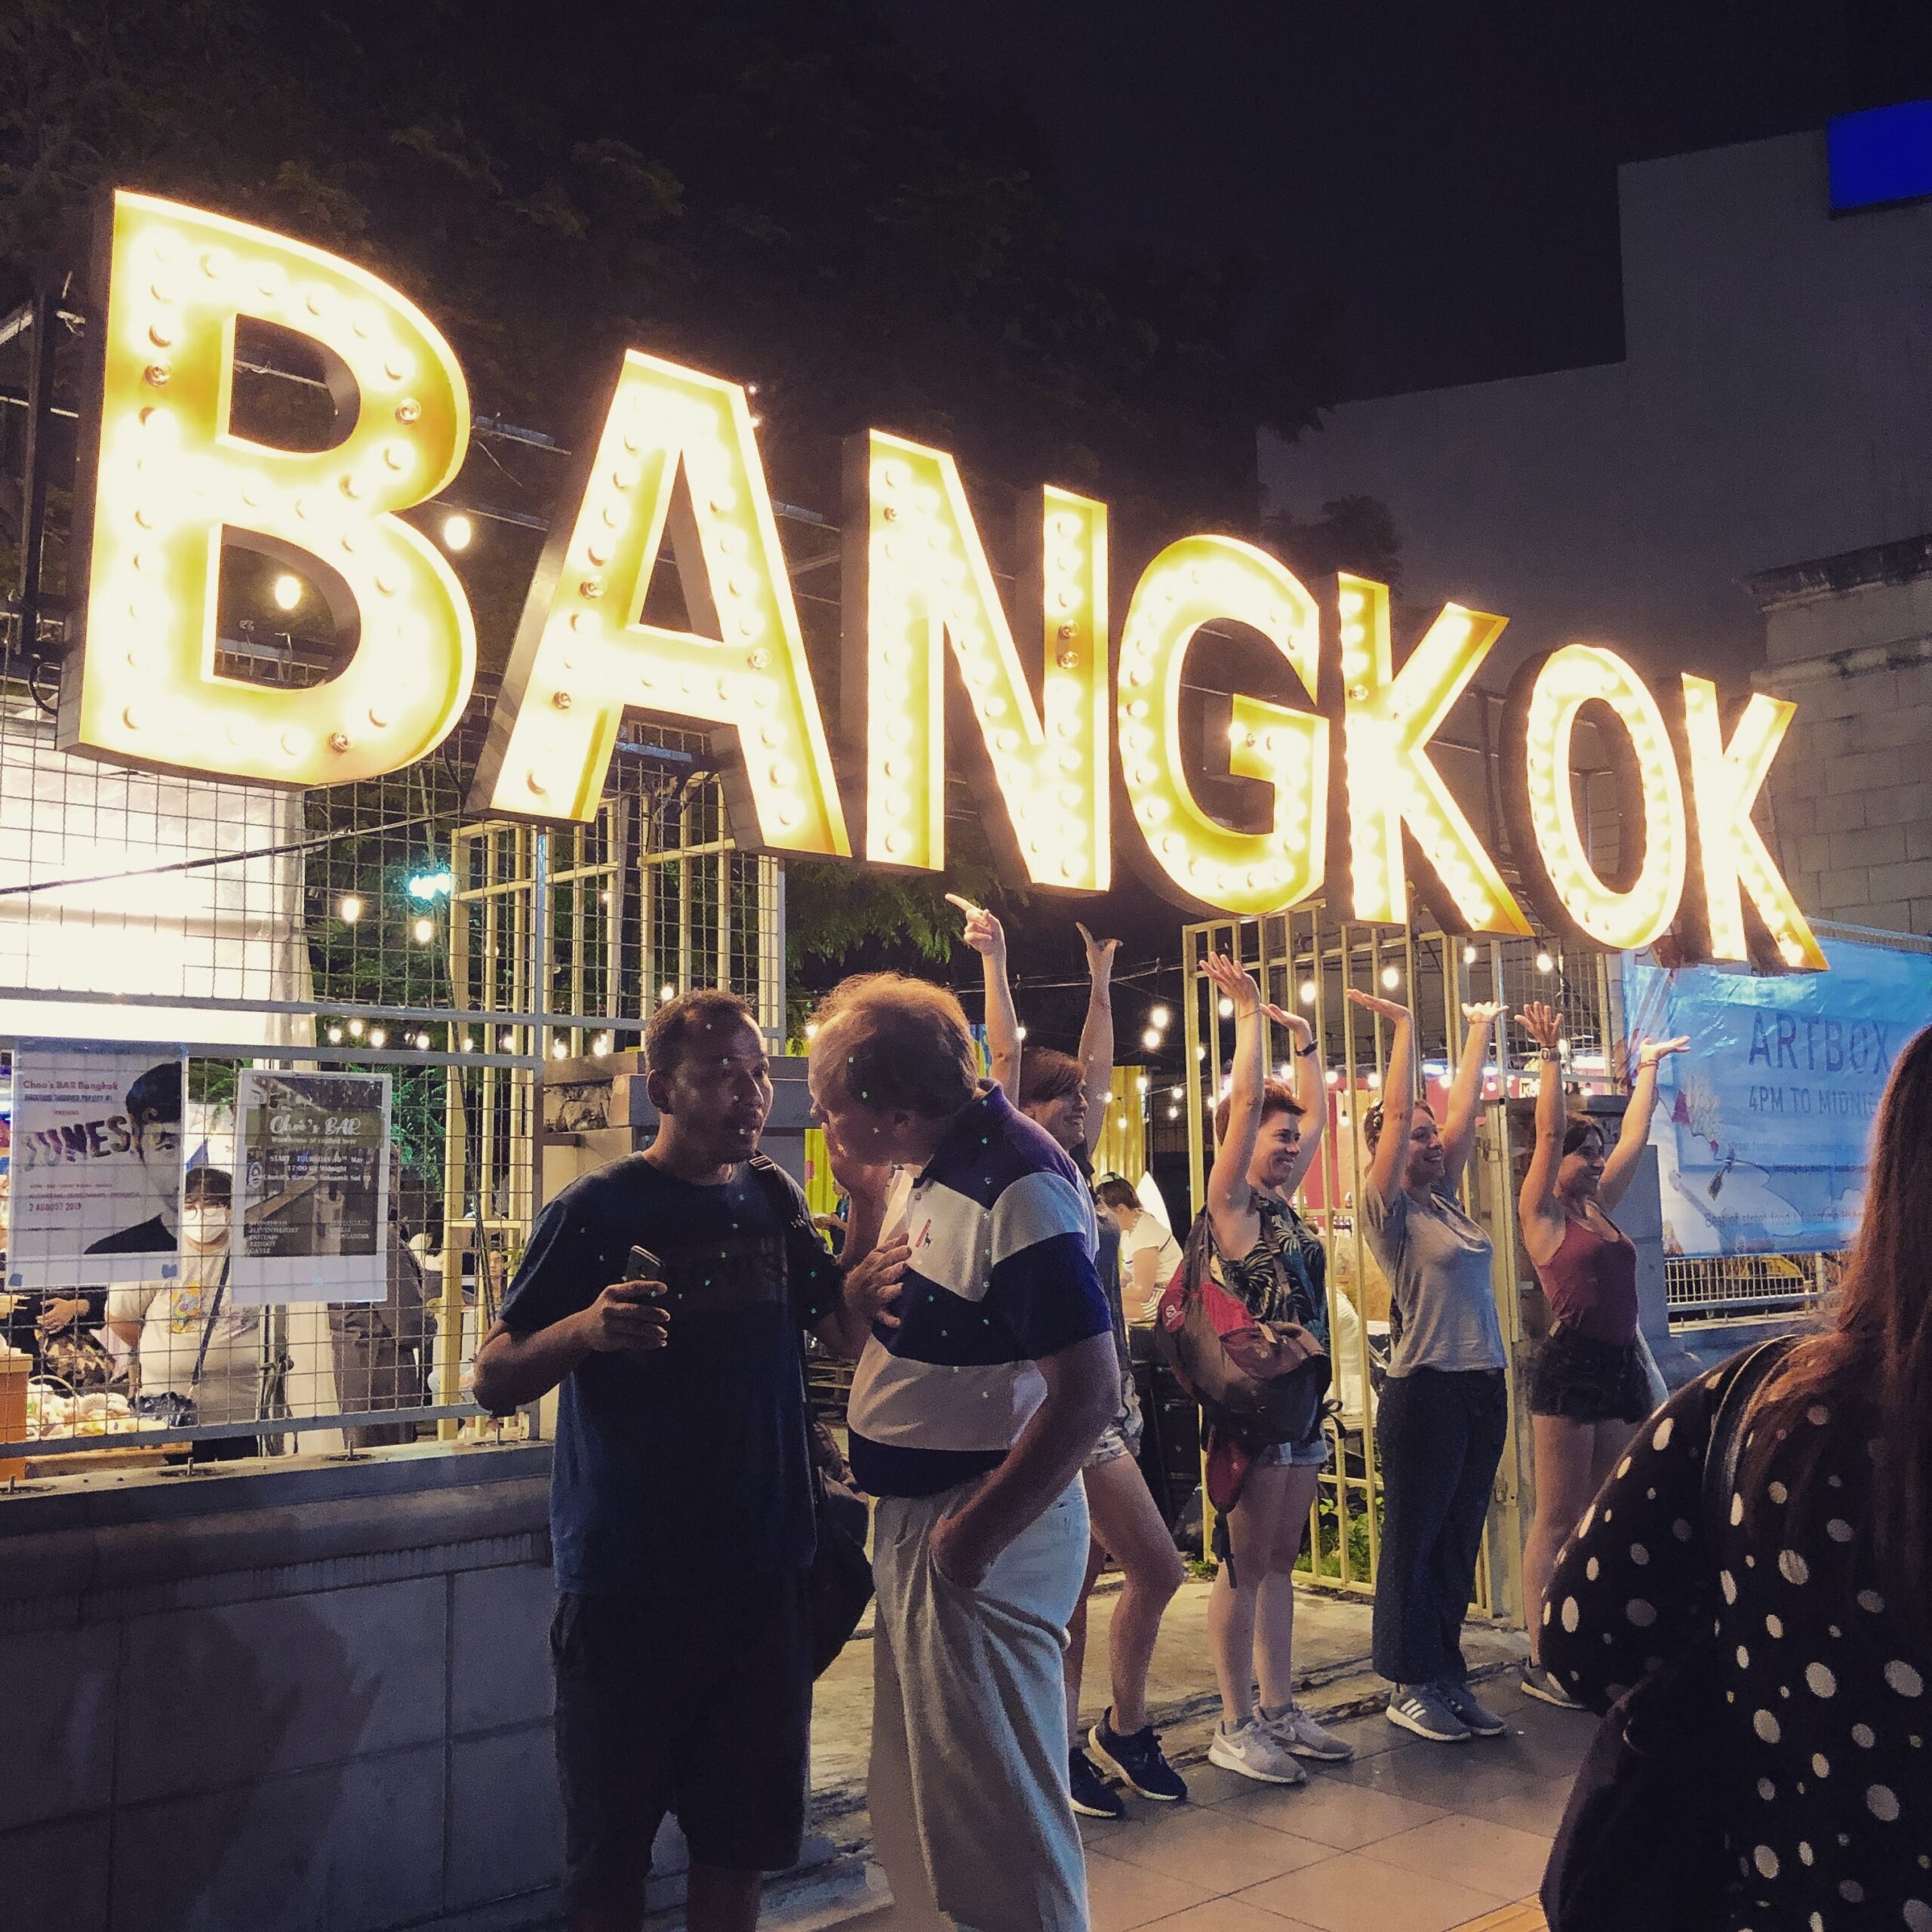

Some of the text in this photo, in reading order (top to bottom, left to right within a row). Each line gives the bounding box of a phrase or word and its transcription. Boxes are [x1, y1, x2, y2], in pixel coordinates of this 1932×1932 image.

[57, 187, 1828, 974] BANGKOK
[1748, 1010, 1890, 1075] ARTBOX
[78, 1081, 118, 1091] Bangkok
[1749, 1084, 1785, 1113] 4PM
[1789, 1087, 1811, 1114] TO
